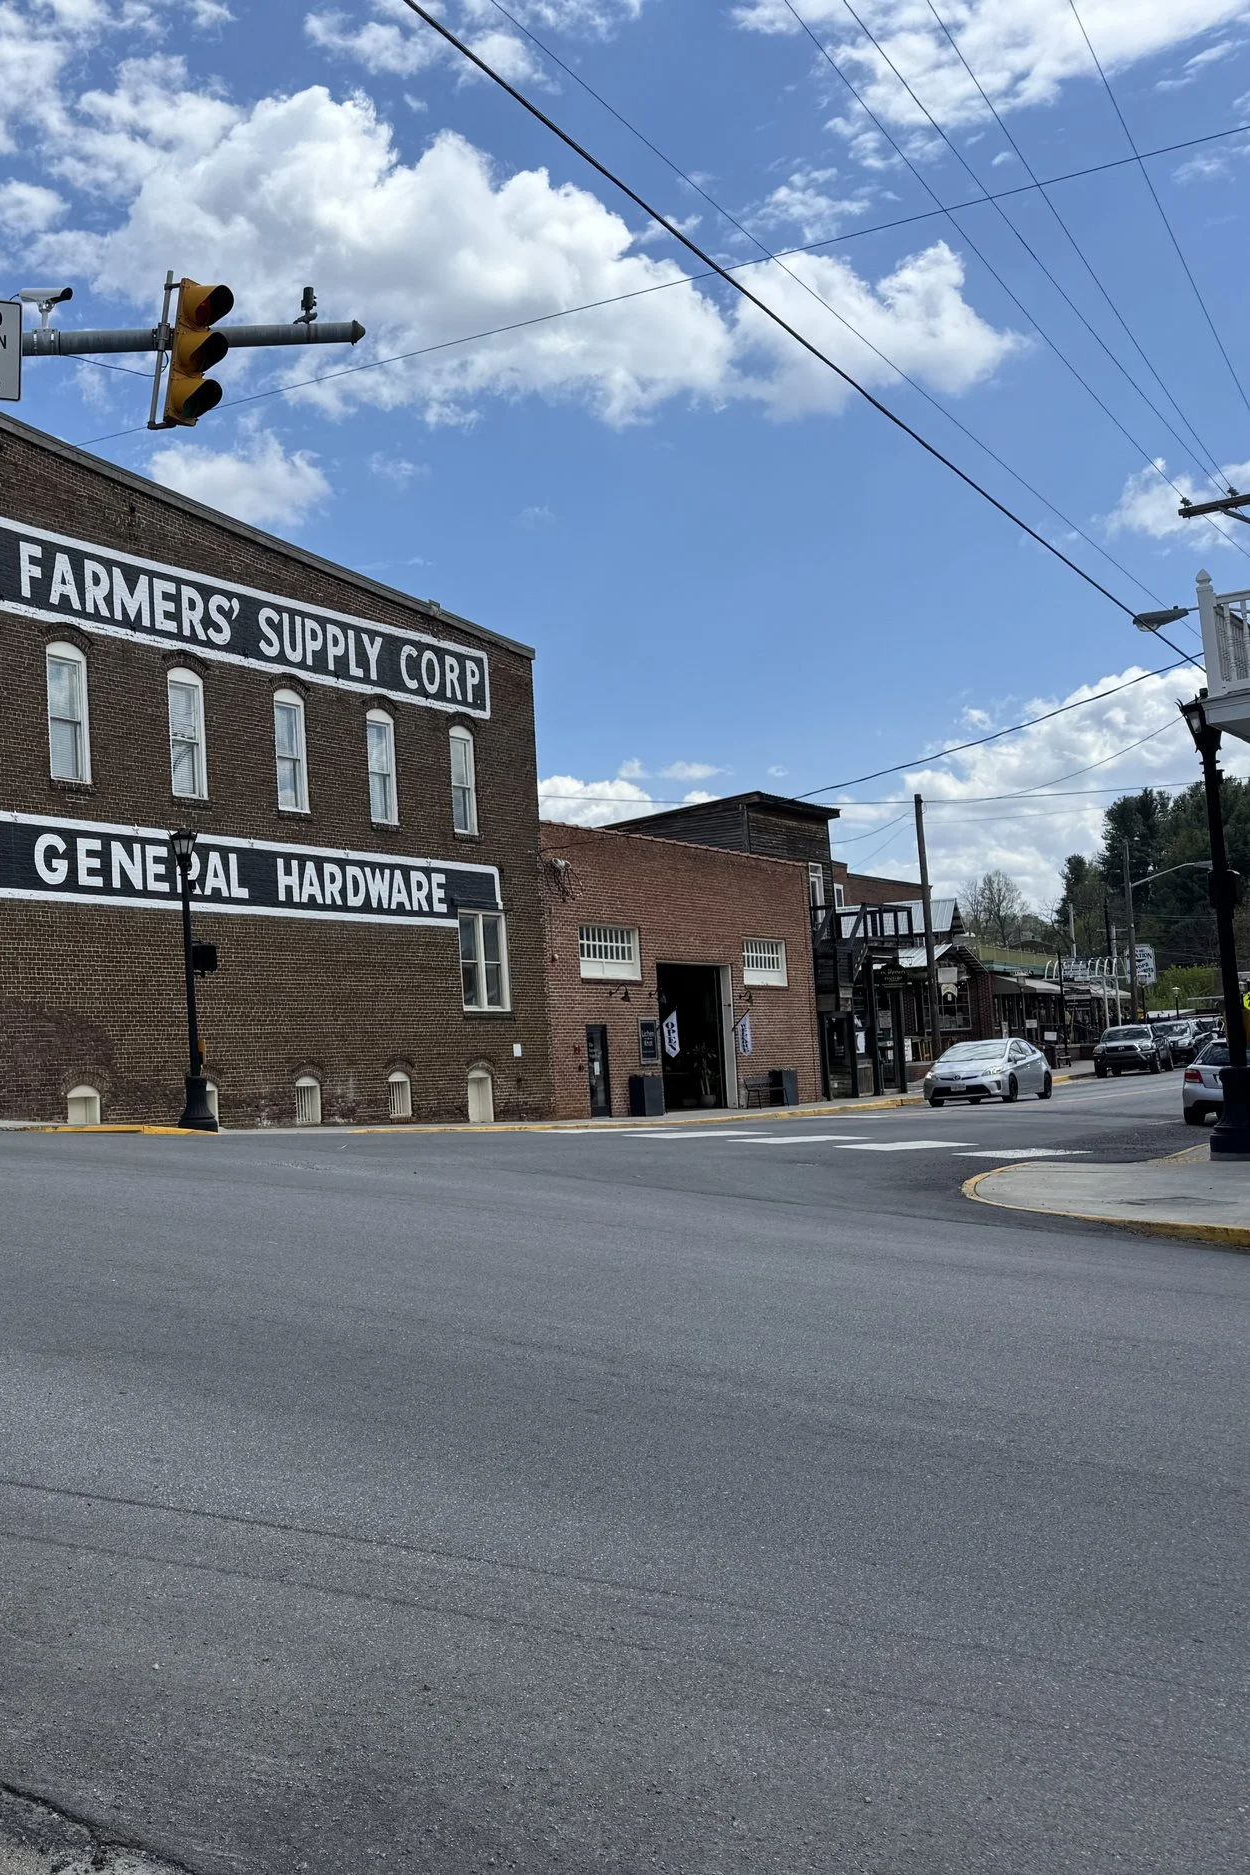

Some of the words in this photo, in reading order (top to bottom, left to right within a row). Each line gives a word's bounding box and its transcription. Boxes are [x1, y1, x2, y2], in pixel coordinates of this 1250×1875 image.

[19, 540, 240, 646] FARMERS'
[257, 607, 384, 681] SUPPLY
[33, 833, 250, 899] GENERAL
[276, 857, 448, 914] HARDWARE
[665, 1021, 677, 1051] OPEN
